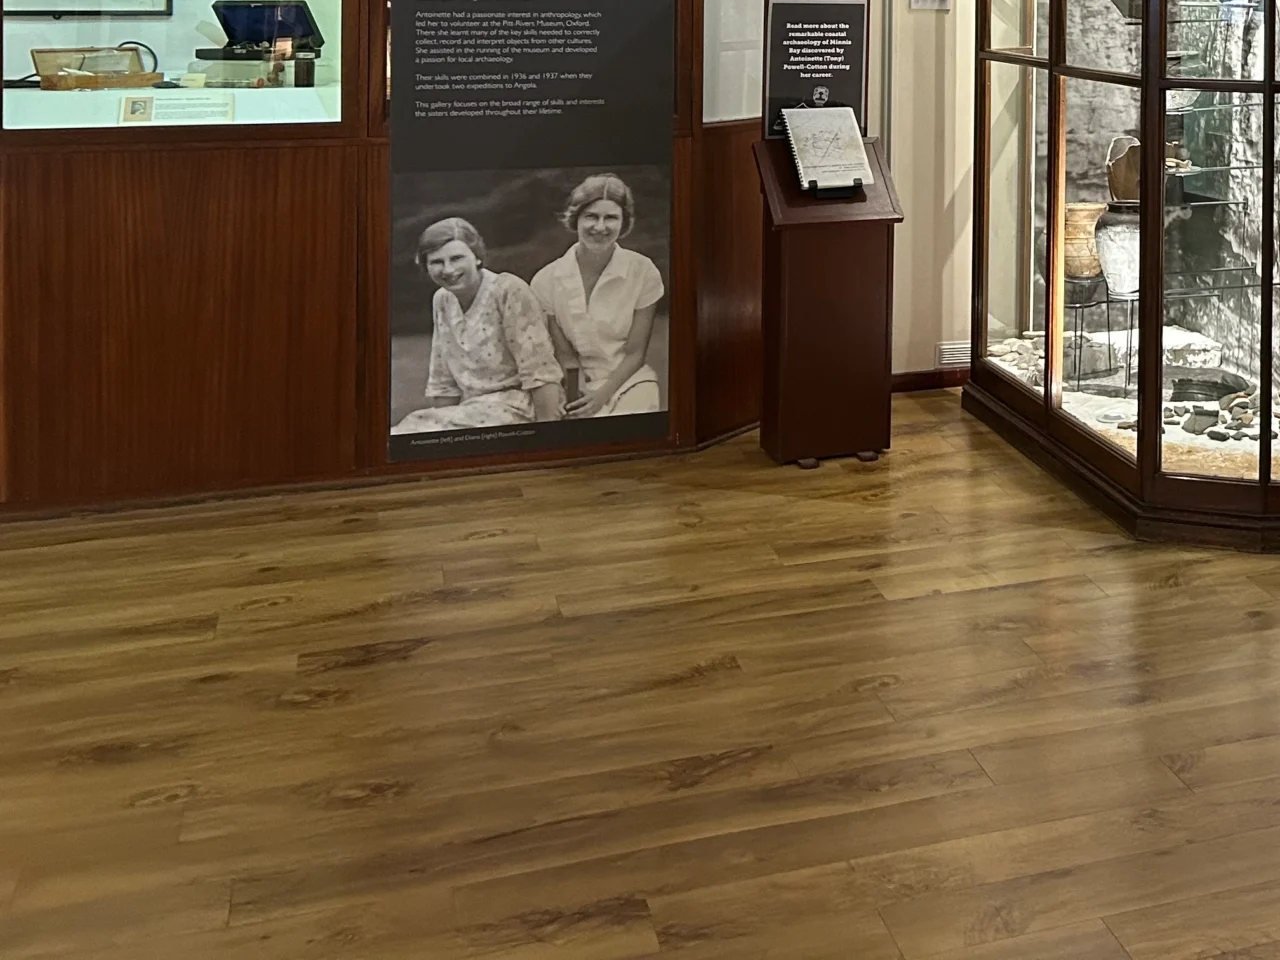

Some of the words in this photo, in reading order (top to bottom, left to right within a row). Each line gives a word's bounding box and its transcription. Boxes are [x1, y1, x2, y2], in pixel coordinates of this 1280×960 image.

[471, 11, 505, 20] passionate
[510, 29, 521, 37] key
[573, 28, 600, 37] correctly
